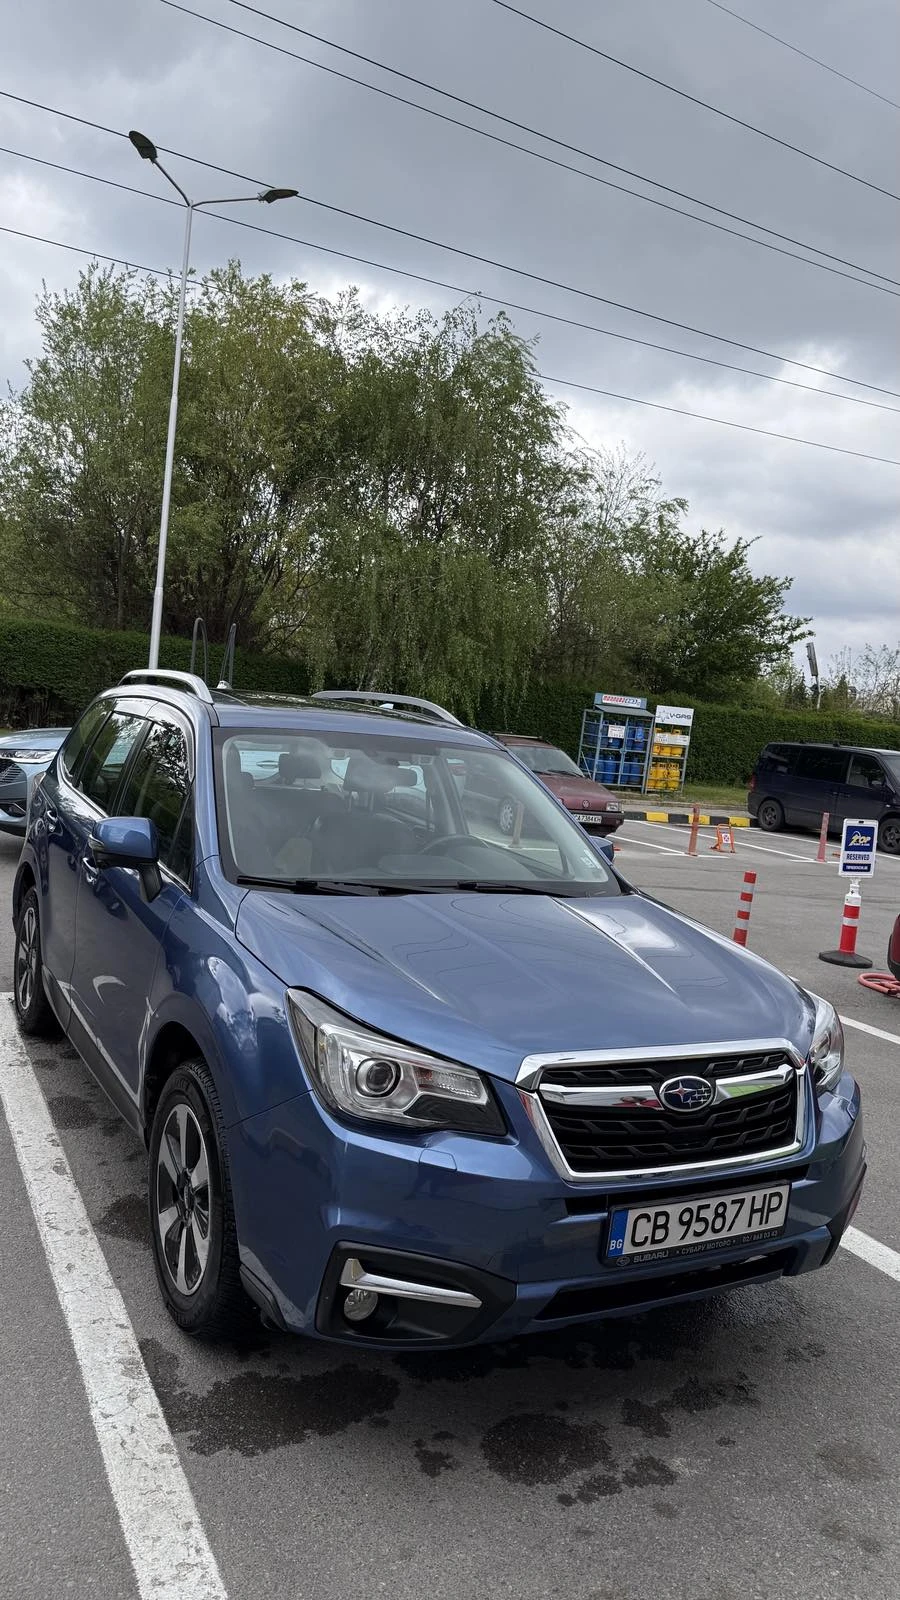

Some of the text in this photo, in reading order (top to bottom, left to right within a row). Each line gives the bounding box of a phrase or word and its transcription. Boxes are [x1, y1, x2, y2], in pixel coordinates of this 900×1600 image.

[846, 853, 870, 861] RESERVED
[630, 1191, 783, 1247] CB 9587 HP
[609, 1238, 623, 1251] BG
[633, 1250, 669, 1263] SUBARU
